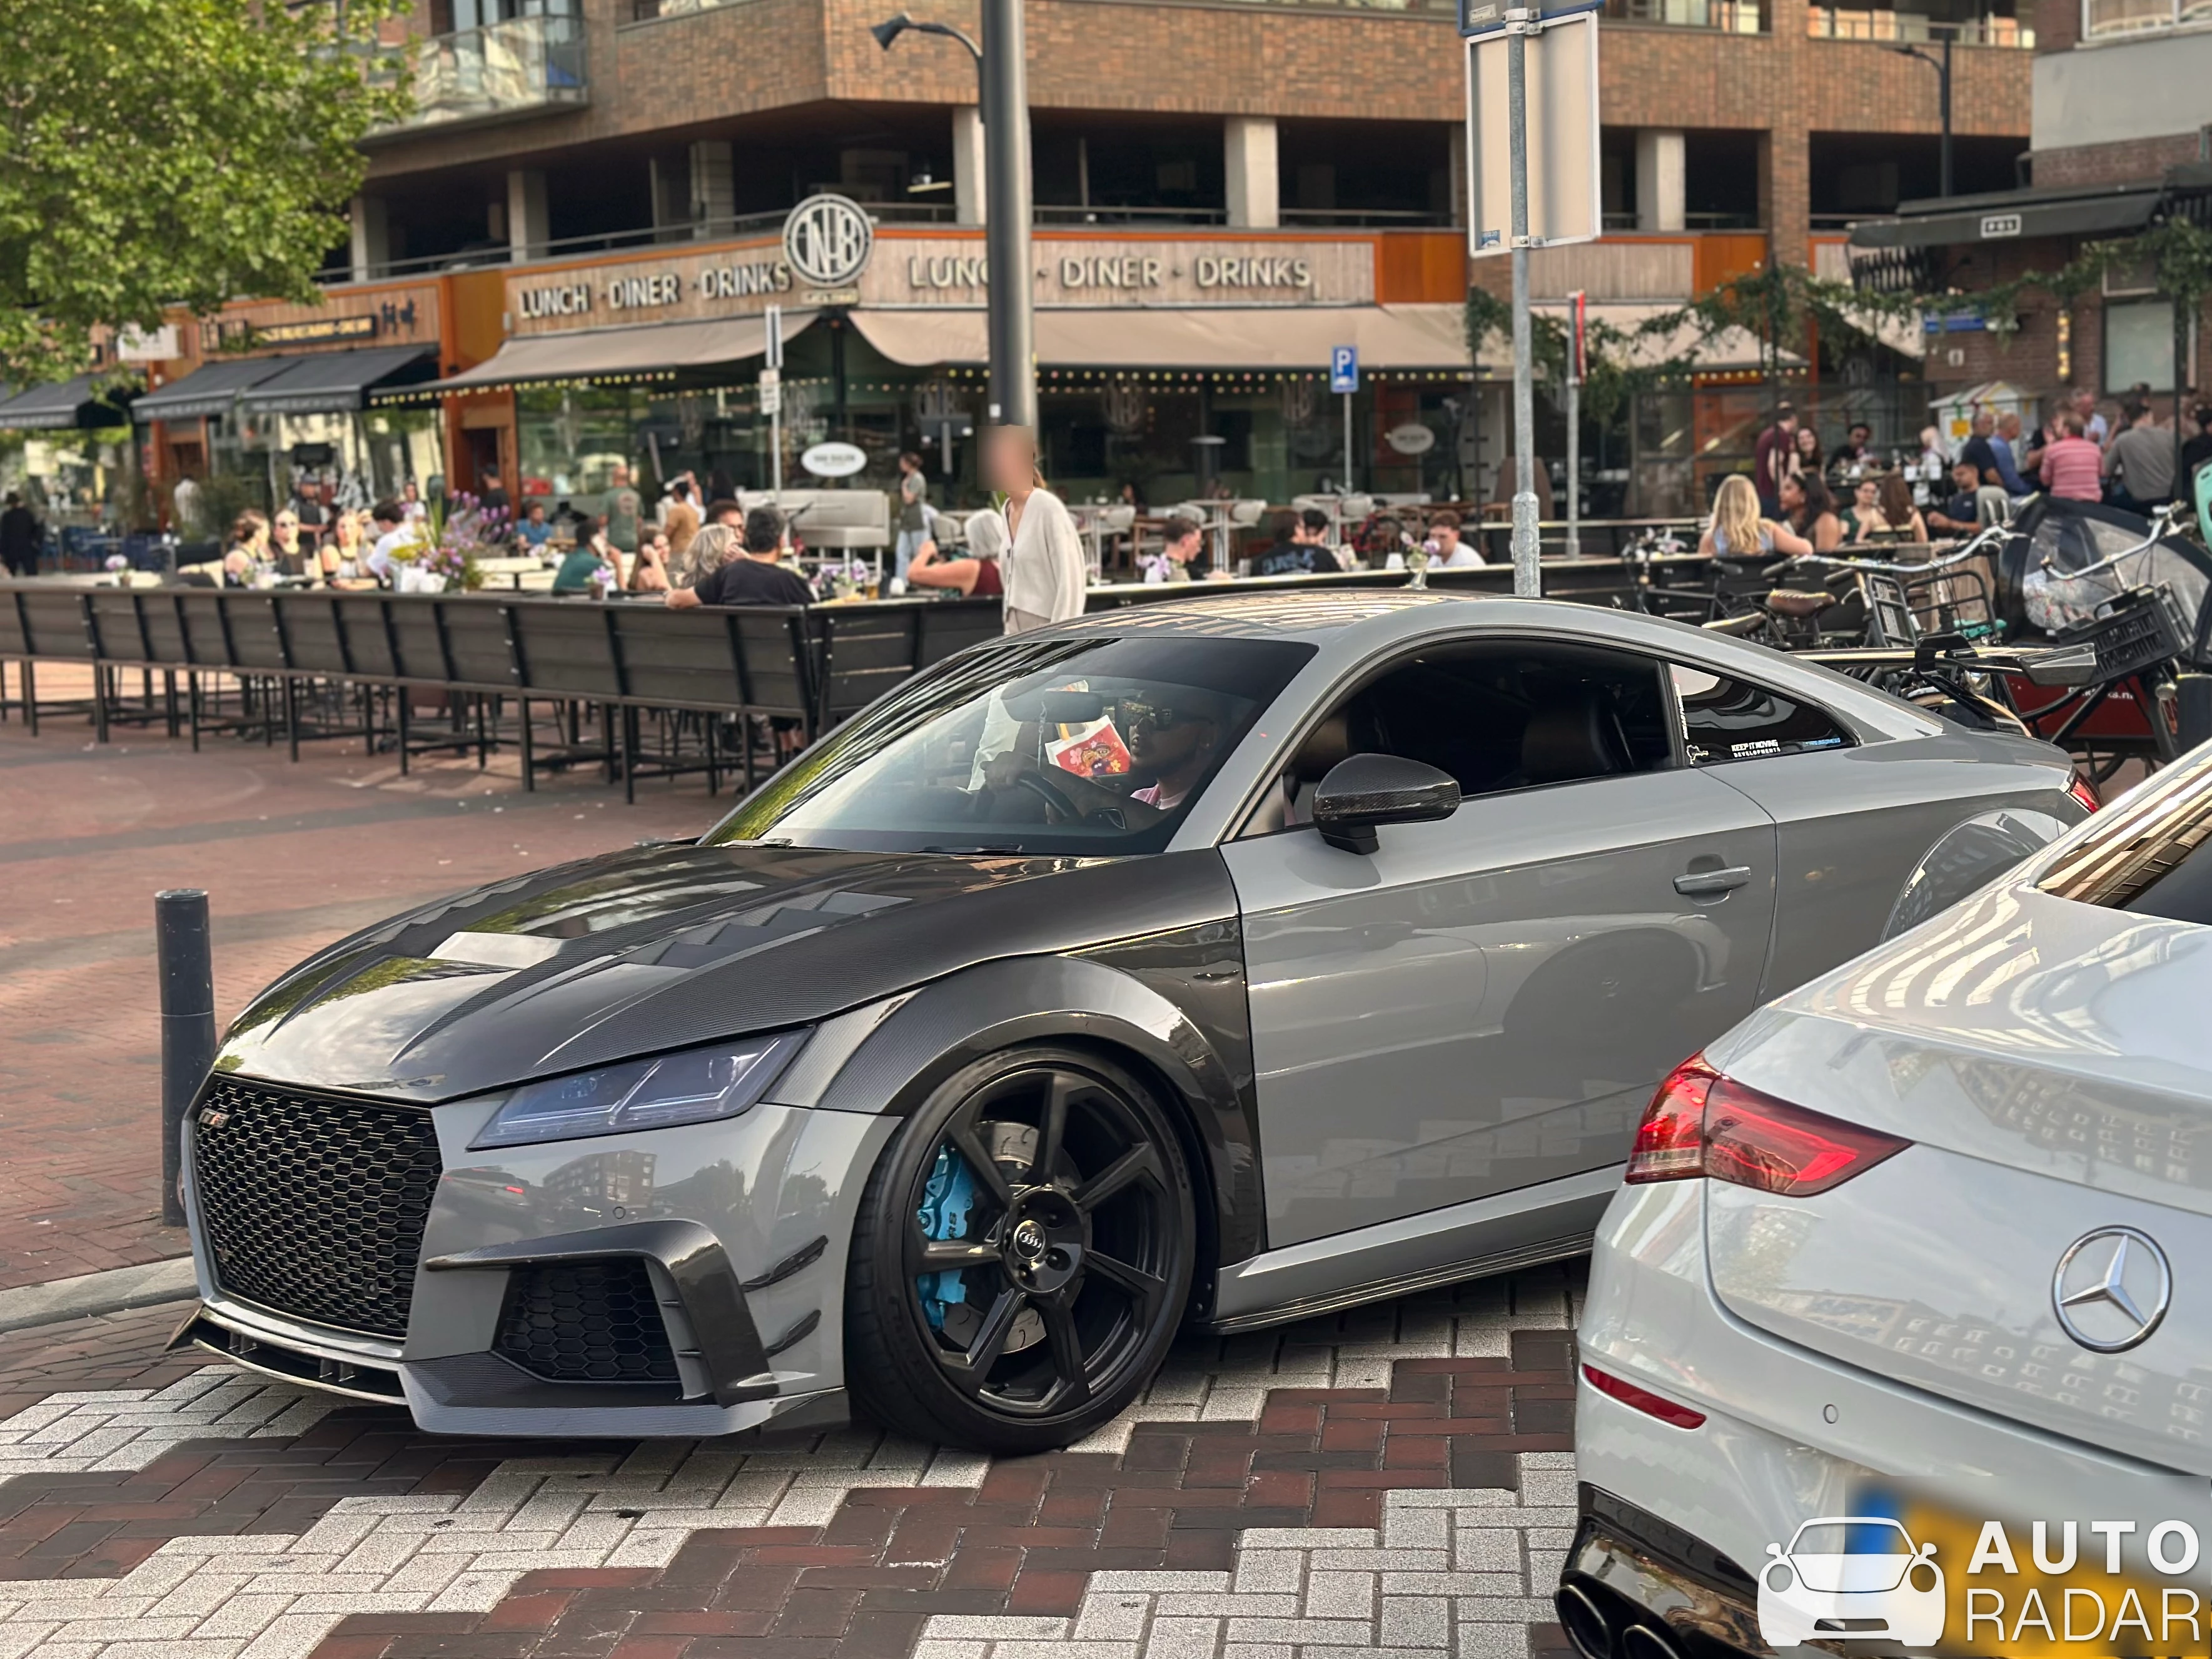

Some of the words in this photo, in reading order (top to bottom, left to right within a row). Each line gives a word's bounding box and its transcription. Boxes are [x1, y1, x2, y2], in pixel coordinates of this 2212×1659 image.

[1061, 256, 1163, 289] DINER
[1195, 256, 1313, 289] DRINKS
[519, 283, 591, 319] LUNCH
[609, 273, 679, 310] DINER
[700, 260, 792, 300] DRINKS
[1338, 350, 1351, 373] P
